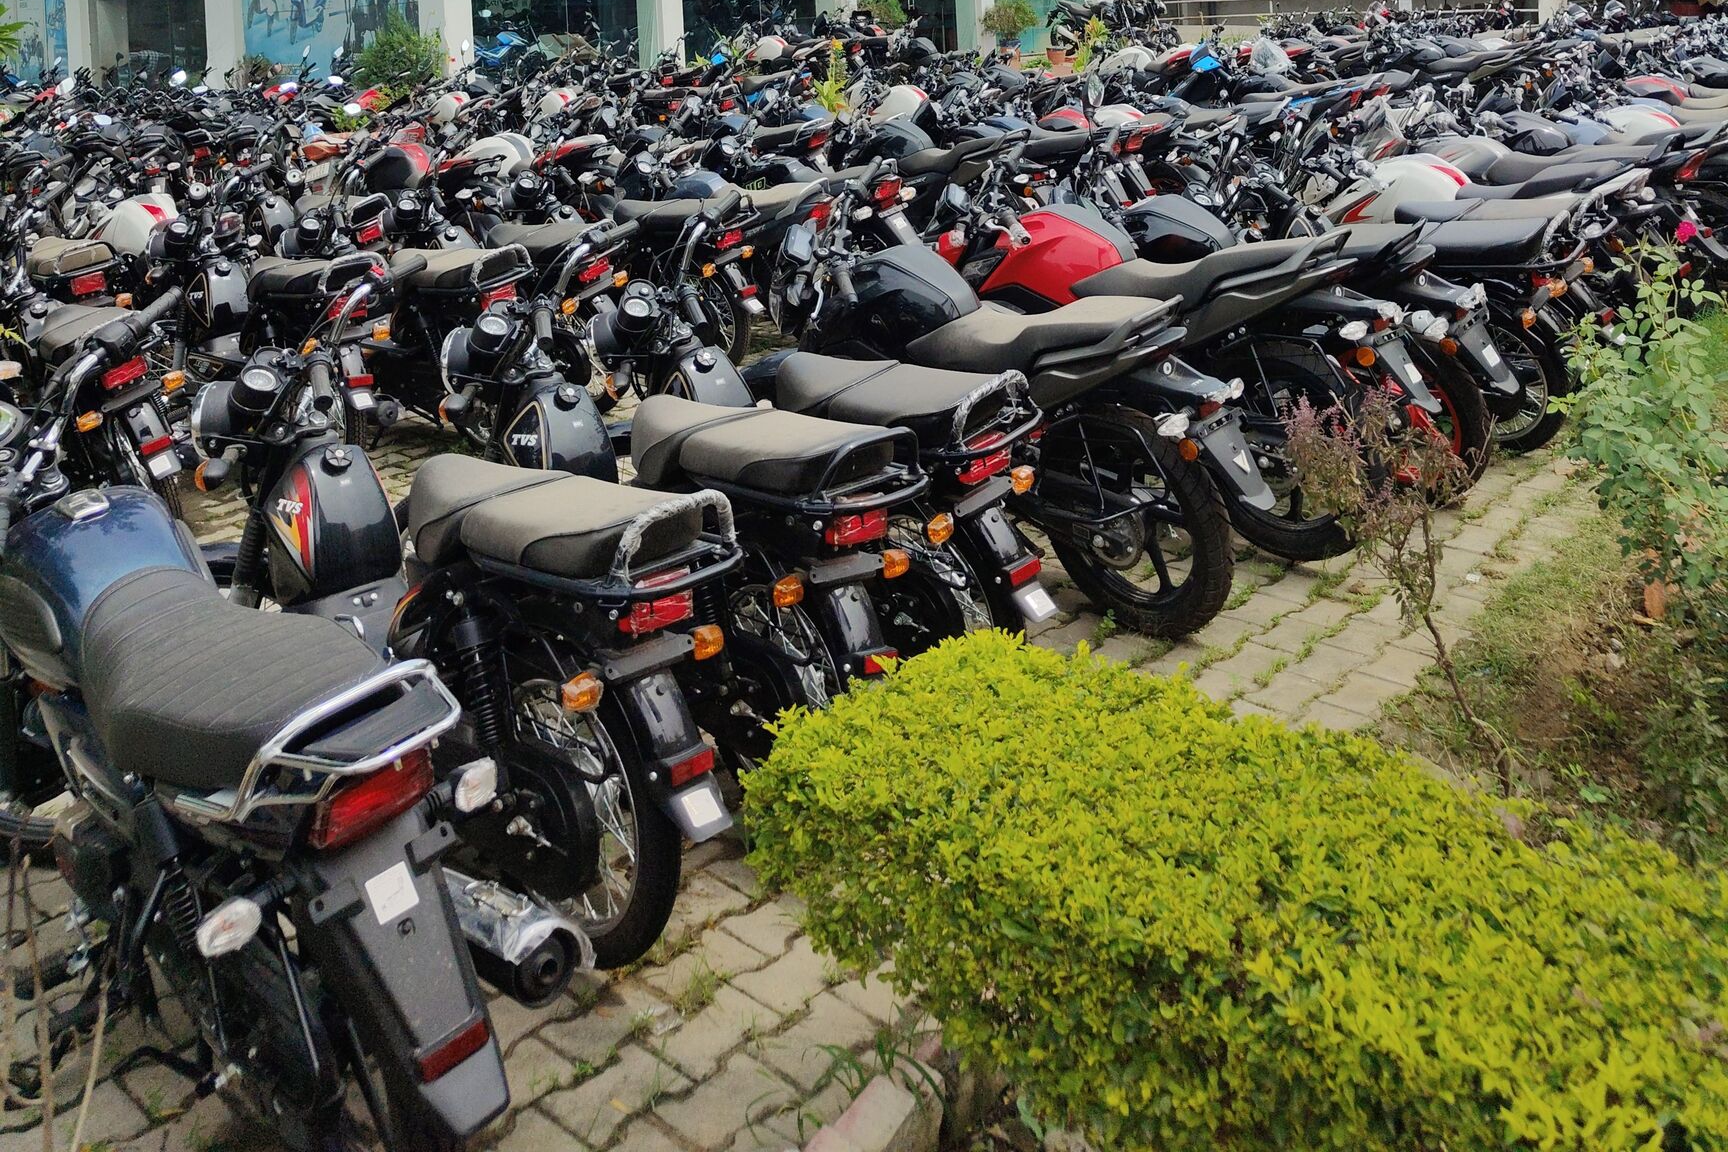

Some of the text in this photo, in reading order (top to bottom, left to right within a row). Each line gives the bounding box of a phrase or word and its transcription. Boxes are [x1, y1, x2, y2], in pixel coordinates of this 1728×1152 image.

[189, 291, 204, 300] TVS
[510, 433, 538, 447] TVS
[276, 498, 304, 515] TVS
